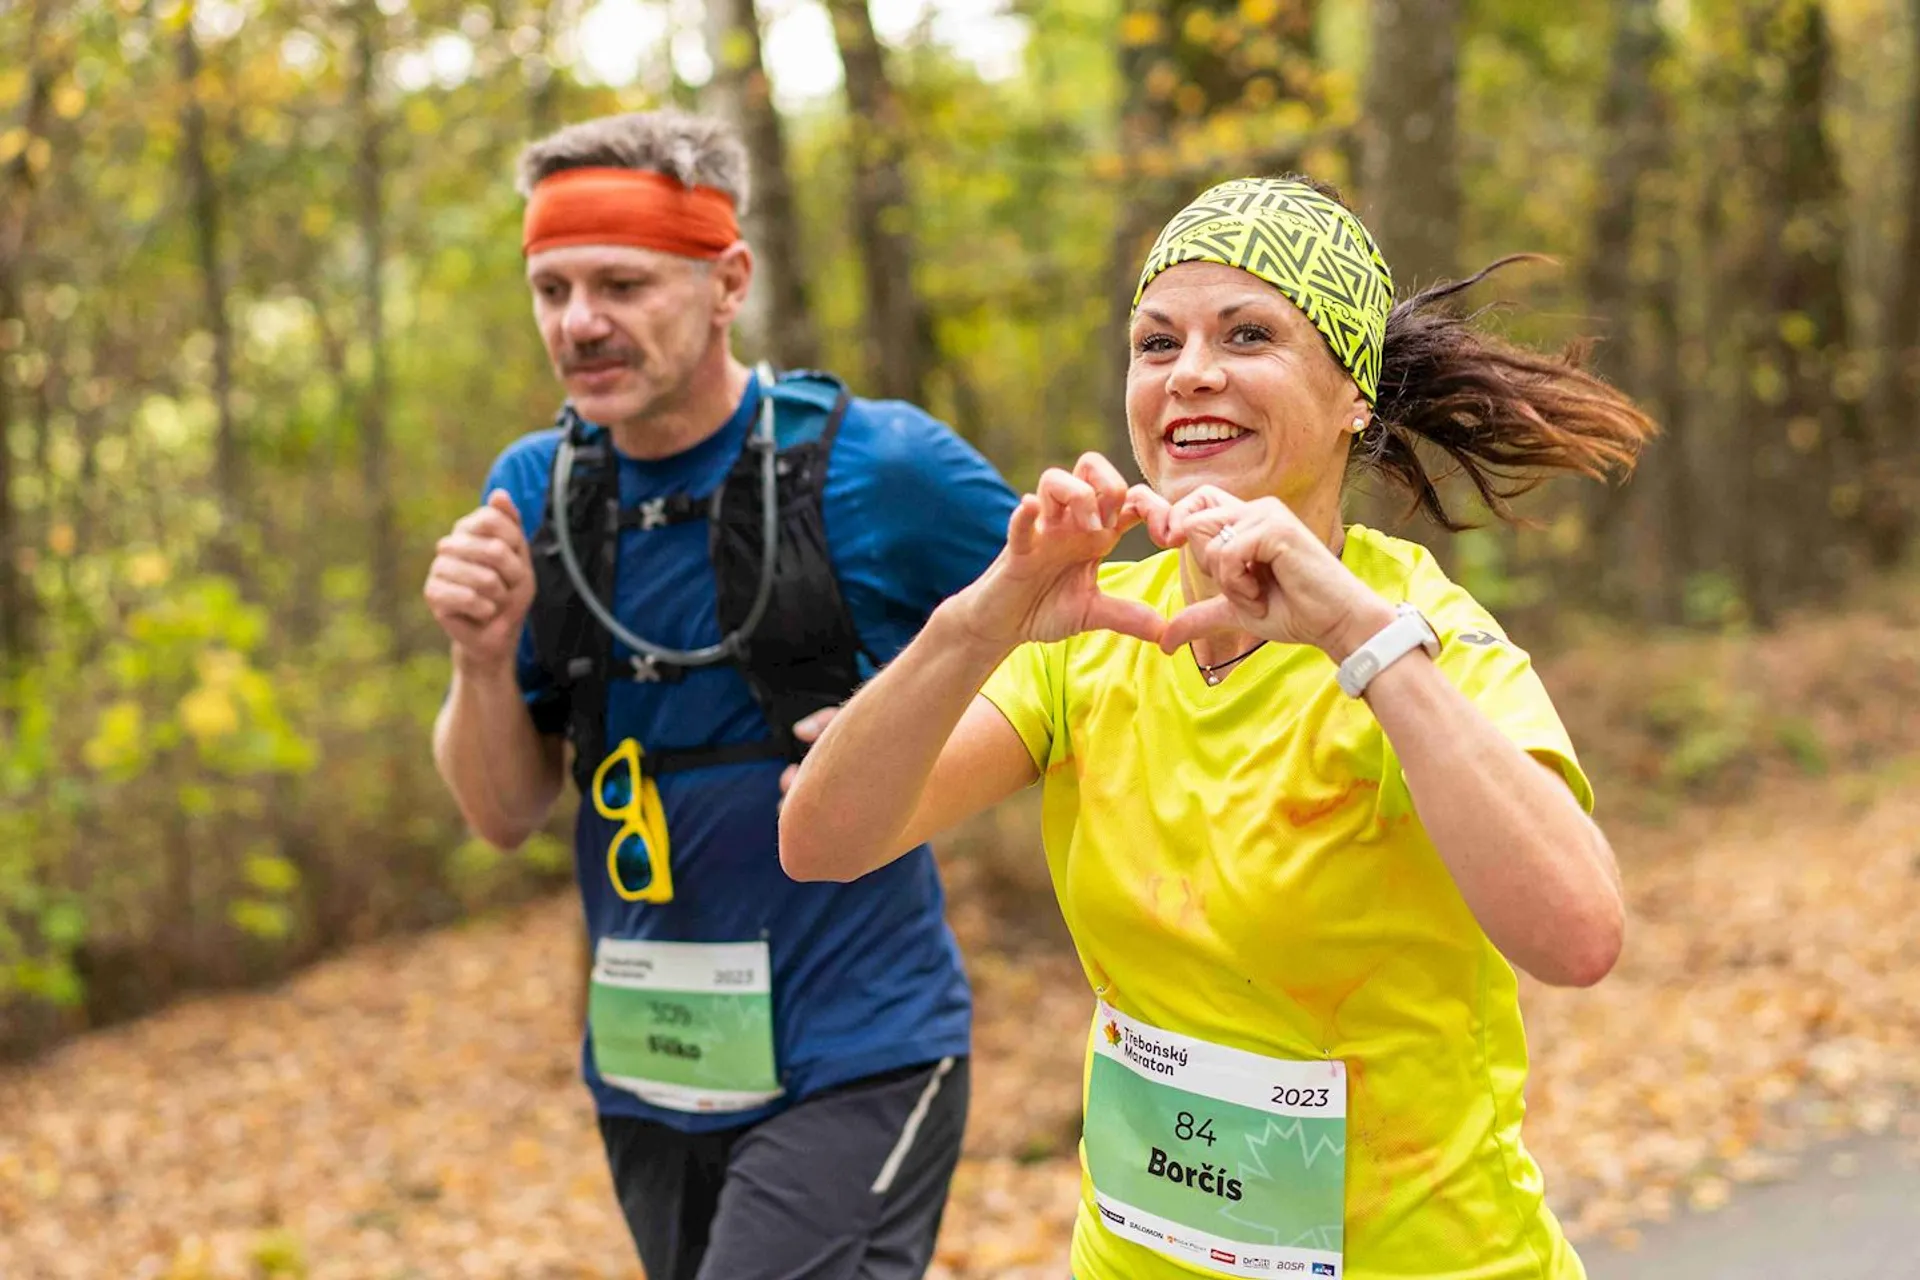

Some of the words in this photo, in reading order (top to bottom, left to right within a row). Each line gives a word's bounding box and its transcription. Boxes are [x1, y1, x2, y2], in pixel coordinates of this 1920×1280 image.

[1124, 1042, 1175, 1077] Maraton
[1271, 1085, 1330, 1108] 2023
[1174, 1111, 1217, 1147] 84
[1147, 1146, 1243, 1202] Borčís
[1129, 1221, 1164, 1240] SALOMON
